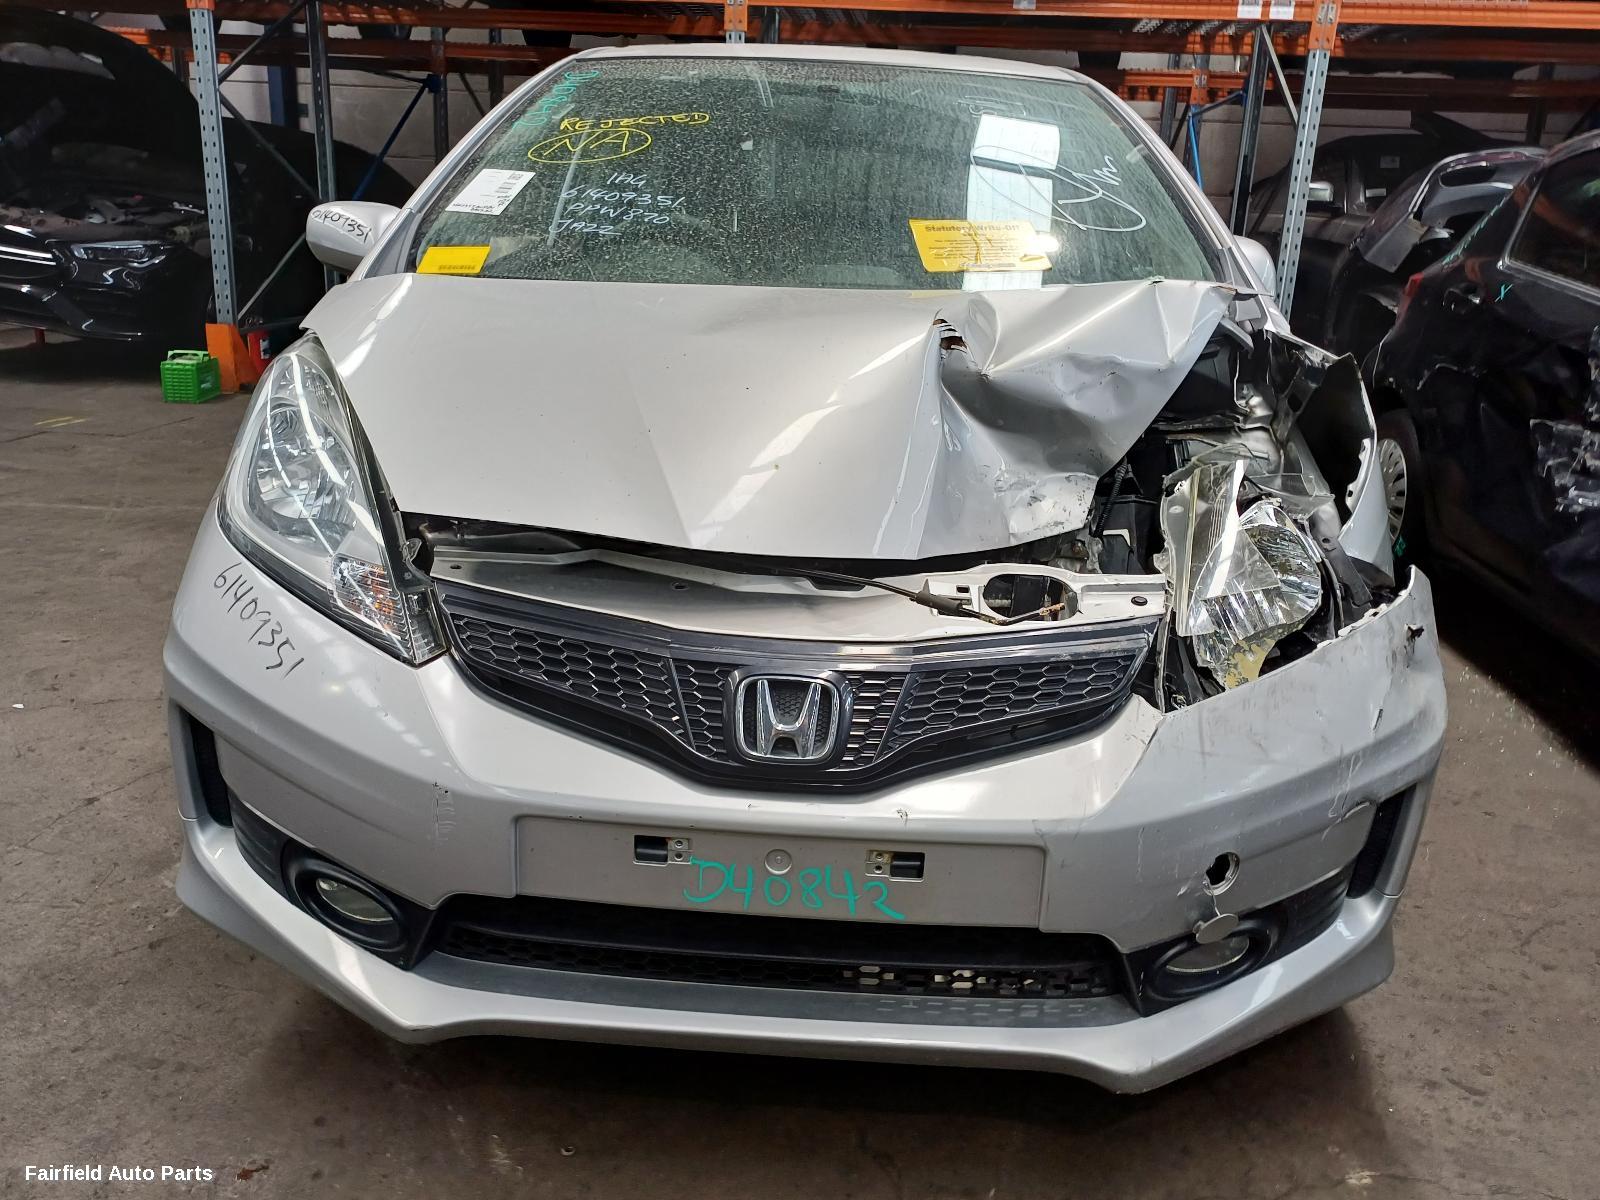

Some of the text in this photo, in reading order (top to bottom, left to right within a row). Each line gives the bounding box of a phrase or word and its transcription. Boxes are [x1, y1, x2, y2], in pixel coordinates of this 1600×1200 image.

[559, 111, 711, 131] REJECTED
[543, 130, 631, 157] NA
[561, 184, 686, 209] 61409351
[563, 202, 670, 224] PPW870
[548, 218, 623, 236] JAZZ
[924, 224, 972, 233] Statutory
[213, 561, 305, 680] 61409351
[682, 855, 906, 921] D40842
